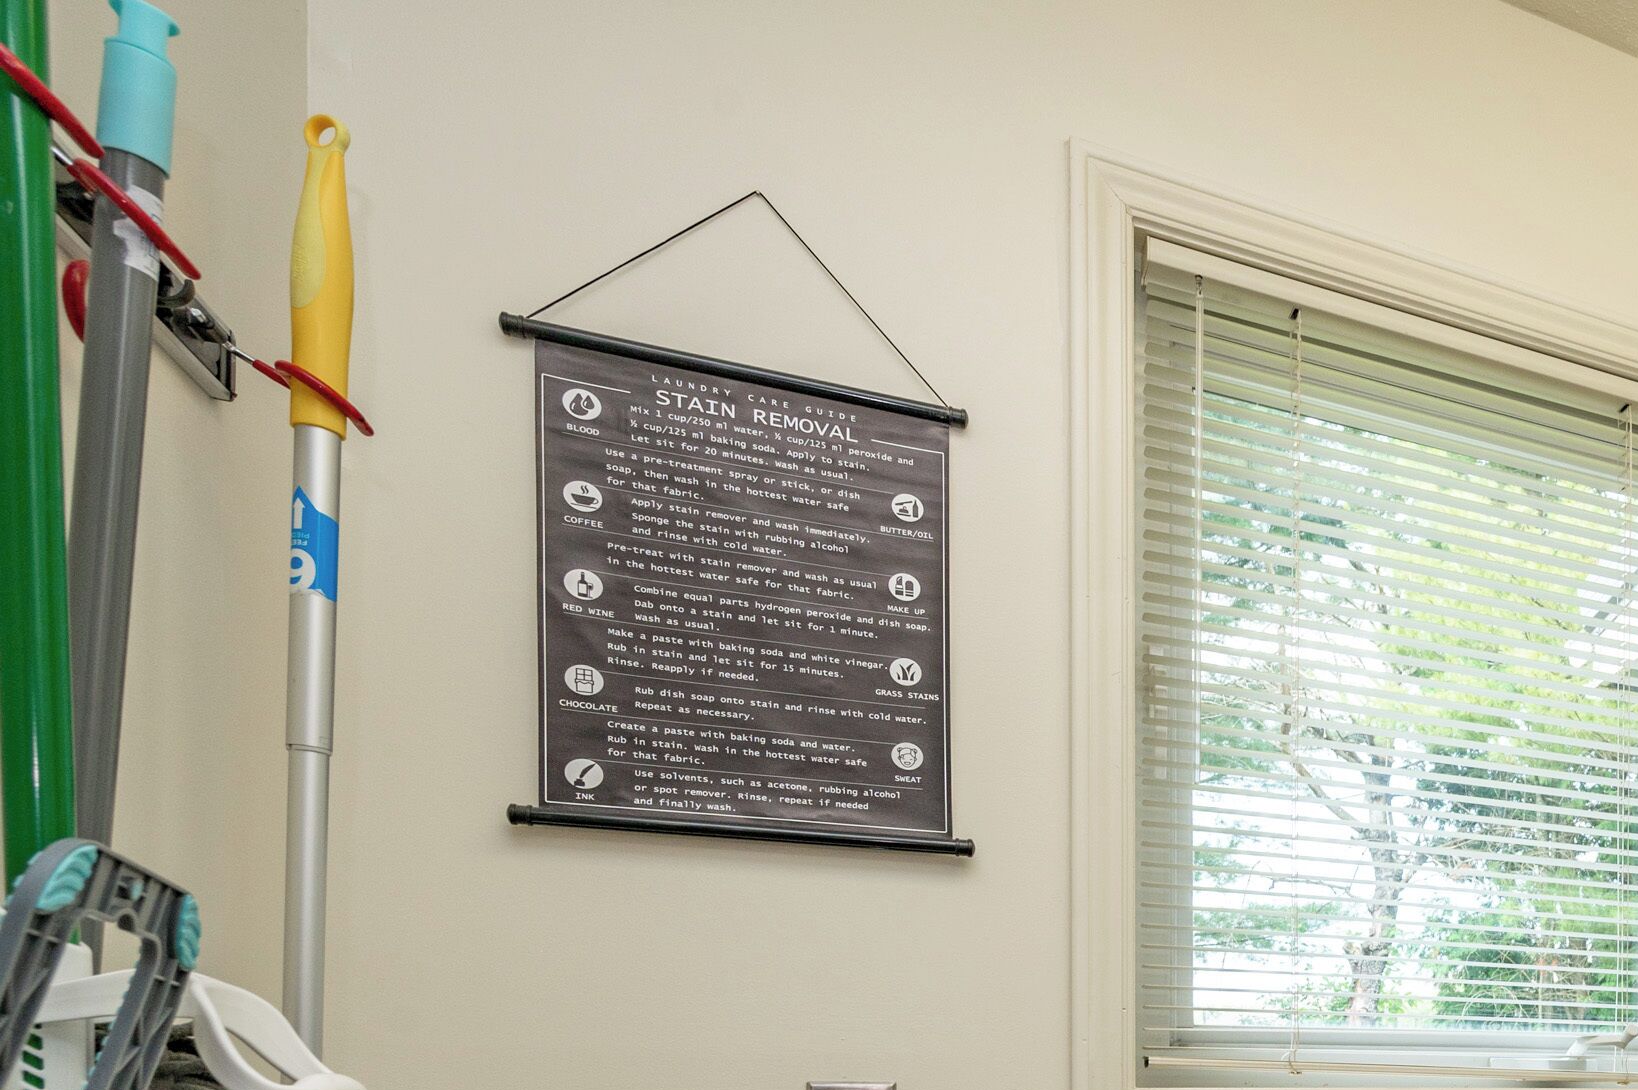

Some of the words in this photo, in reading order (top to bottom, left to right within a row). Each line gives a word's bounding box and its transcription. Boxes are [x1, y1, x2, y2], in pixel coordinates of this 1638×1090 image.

[651, 375, 732, 397] LAUNDRY
[748, 394, 789, 409] CARE
[805, 406, 857, 423] GUIDE
[656, 390, 736, 418] STAIN
[753, 408, 858, 443] REMOVAL
[566, 422, 599, 435] BLOOD
[563, 515, 603, 528] COFFEE
[631, 497, 663, 510] Apply
[669, 504, 699, 515] stain
[705, 511, 746, 522] remover
[752, 518, 770, 526] and
[775, 522, 799, 531] wash
[804, 525, 869, 543] immediately.
[631, 526, 650, 535] and
[657, 530, 687, 541] rinse
[692, 536, 717, 546] with
[723, 541, 747, 550] cold
[752, 545, 786, 556] water.
[632, 512, 669, 525] Sponge
[675, 519, 693, 528] the
[699, 524, 729, 534] stain
[734, 529, 759, 539] with
[765, 534, 804, 548] rubbing
[810, 541, 848, 553] alcohol
[880, 525, 933, 541] BUTTER/OIL
[562, 602, 582, 612] RED
[588, 607, 614, 618] WINE
[633, 584, 677, 597] Combine
[683, 592, 712, 602] equal
[719, 598, 749, 607] parts
[754, 600, 801, 614] hydrogen
[806, 609, 851, 621] peroxide
[856, 616, 873, 624] and
[878, 618, 900, 627] dish
[905, 623, 930, 632] soap.
[887, 604, 909, 614] MAKE
[607, 656, 643, 668] Rinse.
[651, 662, 695, 675] Reapply
[700, 667, 713, 676] if
[718, 671, 758, 681] needed.
[875, 688, 902, 697] GRASS
[907, 692, 939, 700] STAINS
[558, 698, 618, 712] CHOCOLATE
[634, 769, 653, 778] Use
[659, 771, 713, 784] solvents,
[720, 777, 744, 785] such
[767, 782, 812, 792] acetone,
[819, 785, 858, 796] rubbing
[863, 788, 900, 798] alcohol
[894, 774, 921, 783] SWEAT
[575, 792, 594, 800] INK
[653, 786, 677, 794] spot
[684, 789, 730, 798] remover.
[737, 792, 771, 802] Rinse,
[779, 796, 812, 805] repeat
[818, 798, 830, 806] if
[835, 801, 868, 809] needed
